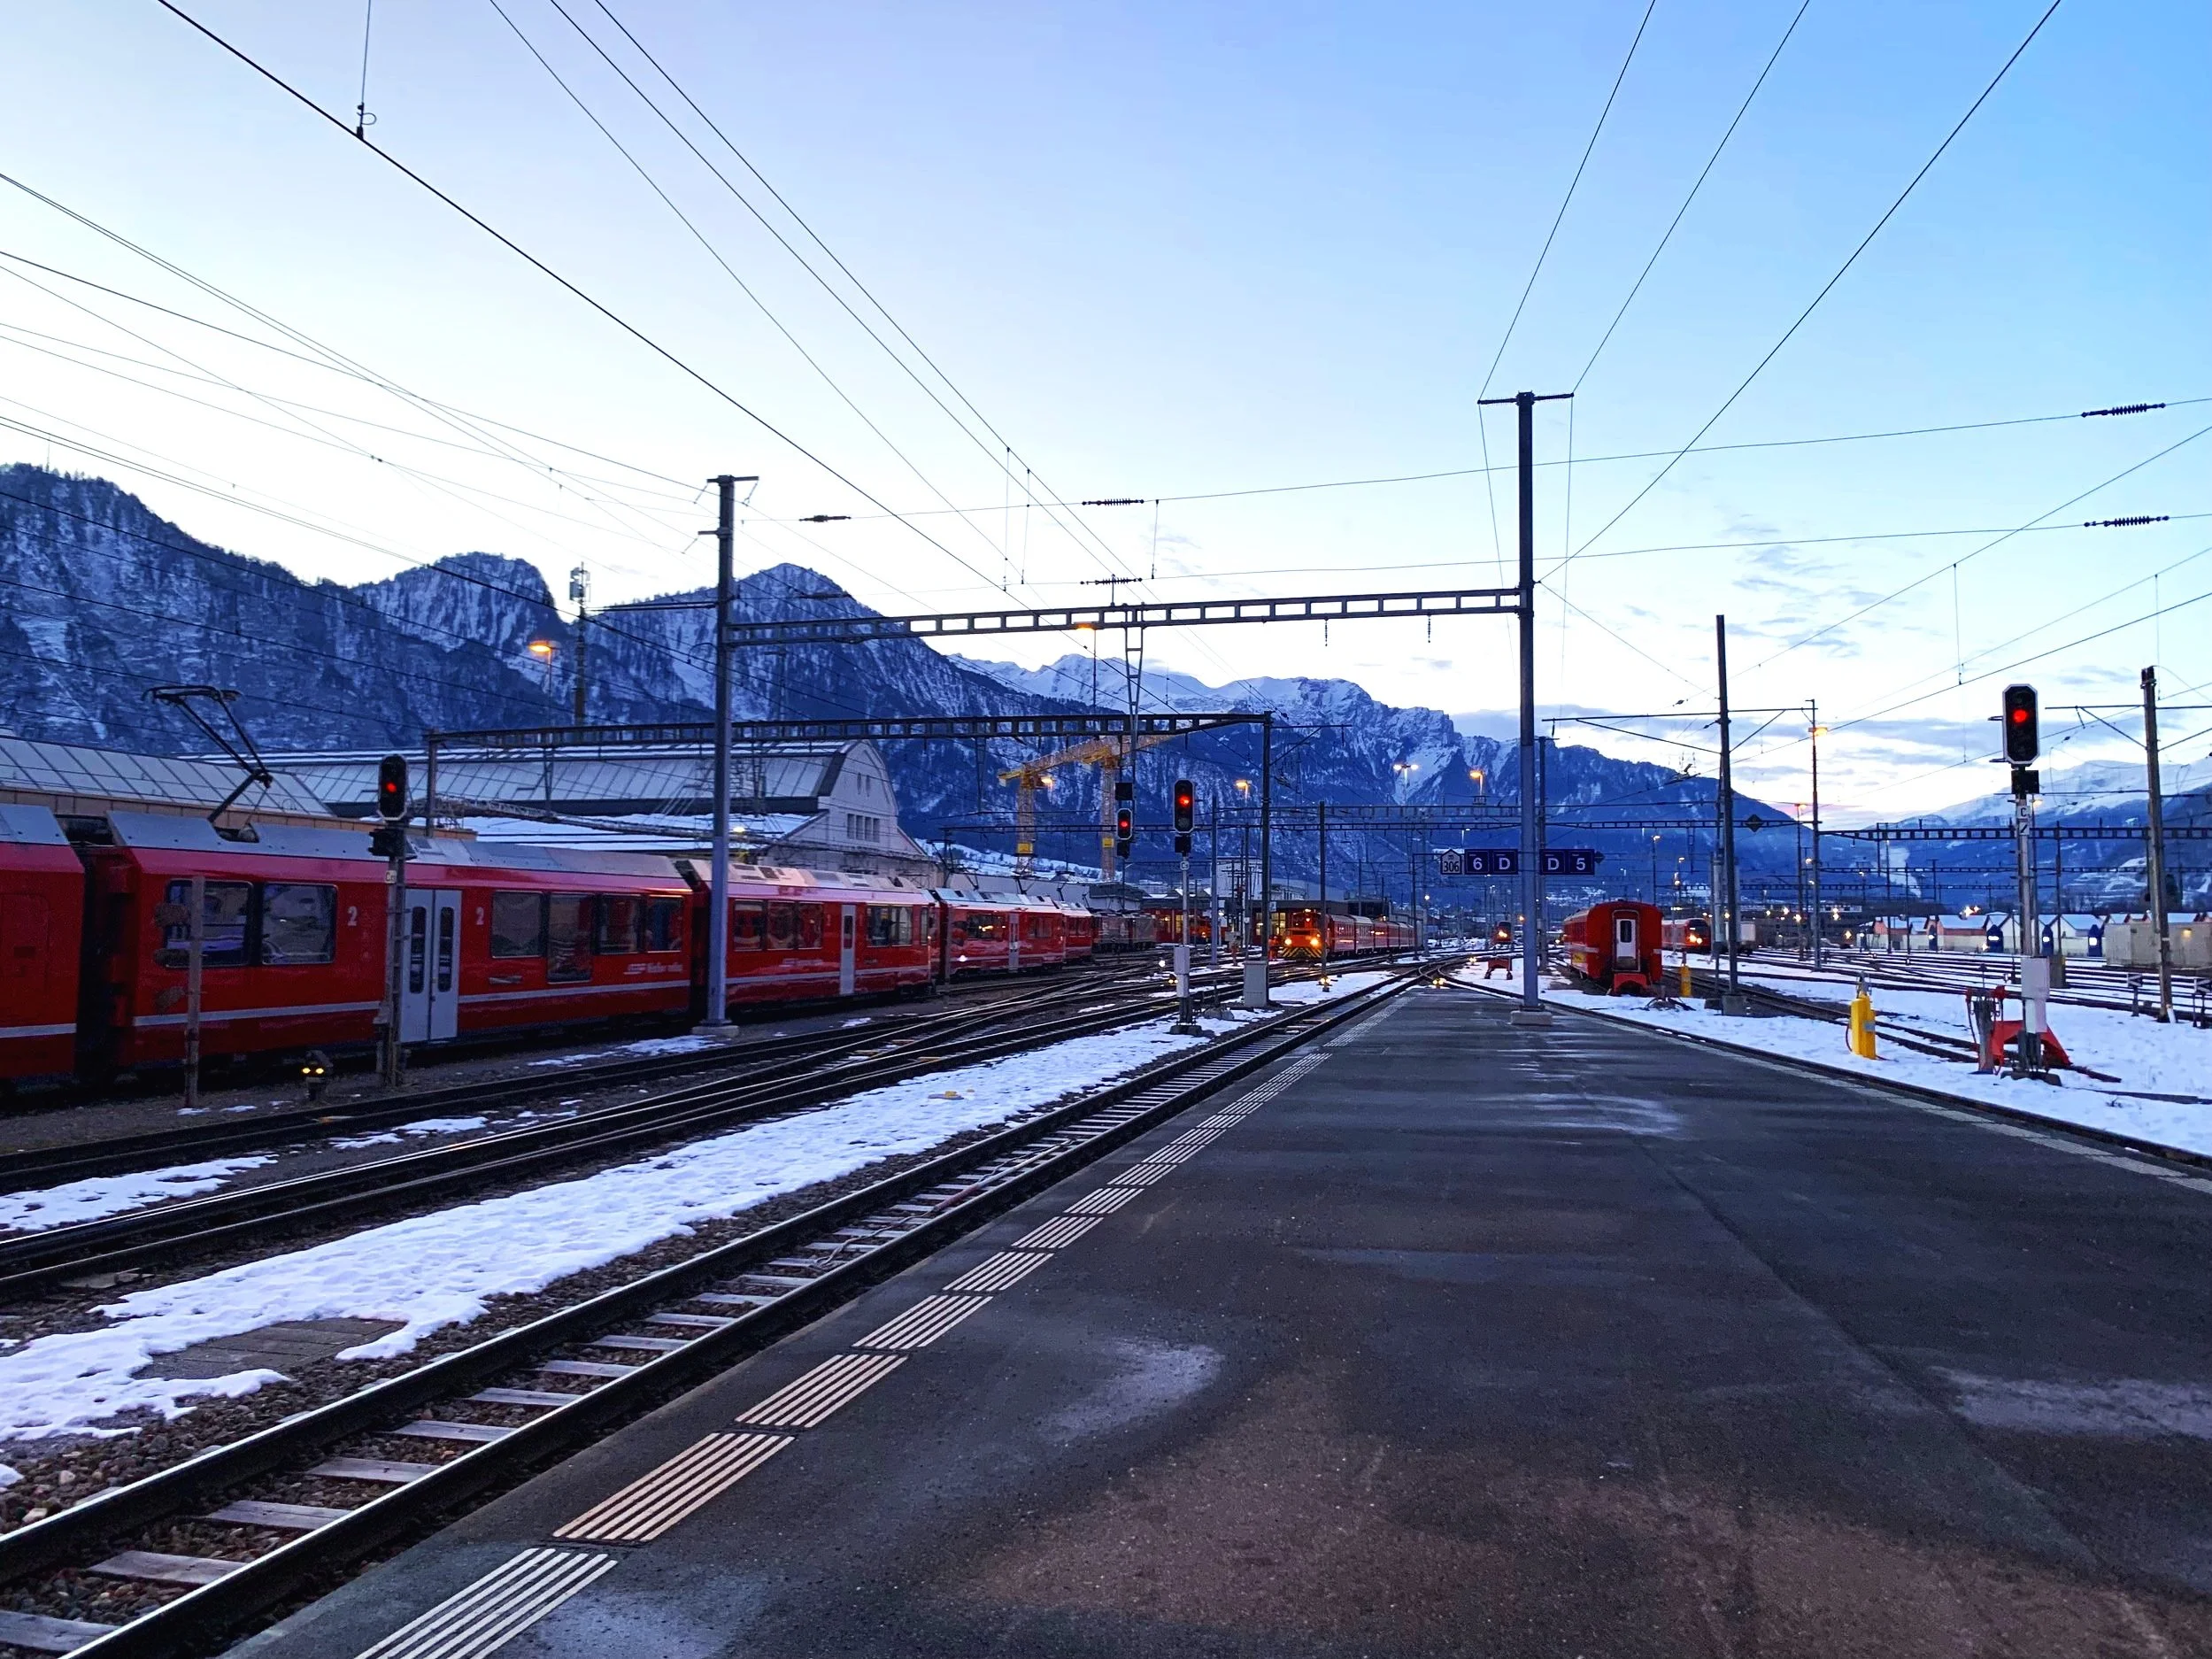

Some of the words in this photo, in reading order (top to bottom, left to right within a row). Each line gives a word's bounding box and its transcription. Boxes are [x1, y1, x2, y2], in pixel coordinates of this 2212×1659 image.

[2020, 806, 2027, 817] C
[1444, 860, 1460, 872] 306
[1473, 857, 1483, 870] 6
[1499, 857, 1511, 870] D
[1547, 857, 1560, 871] D
[1576, 857, 1586, 871] 5
[347, 906, 358, 927] 2
[475, 907, 485, 925] 2
